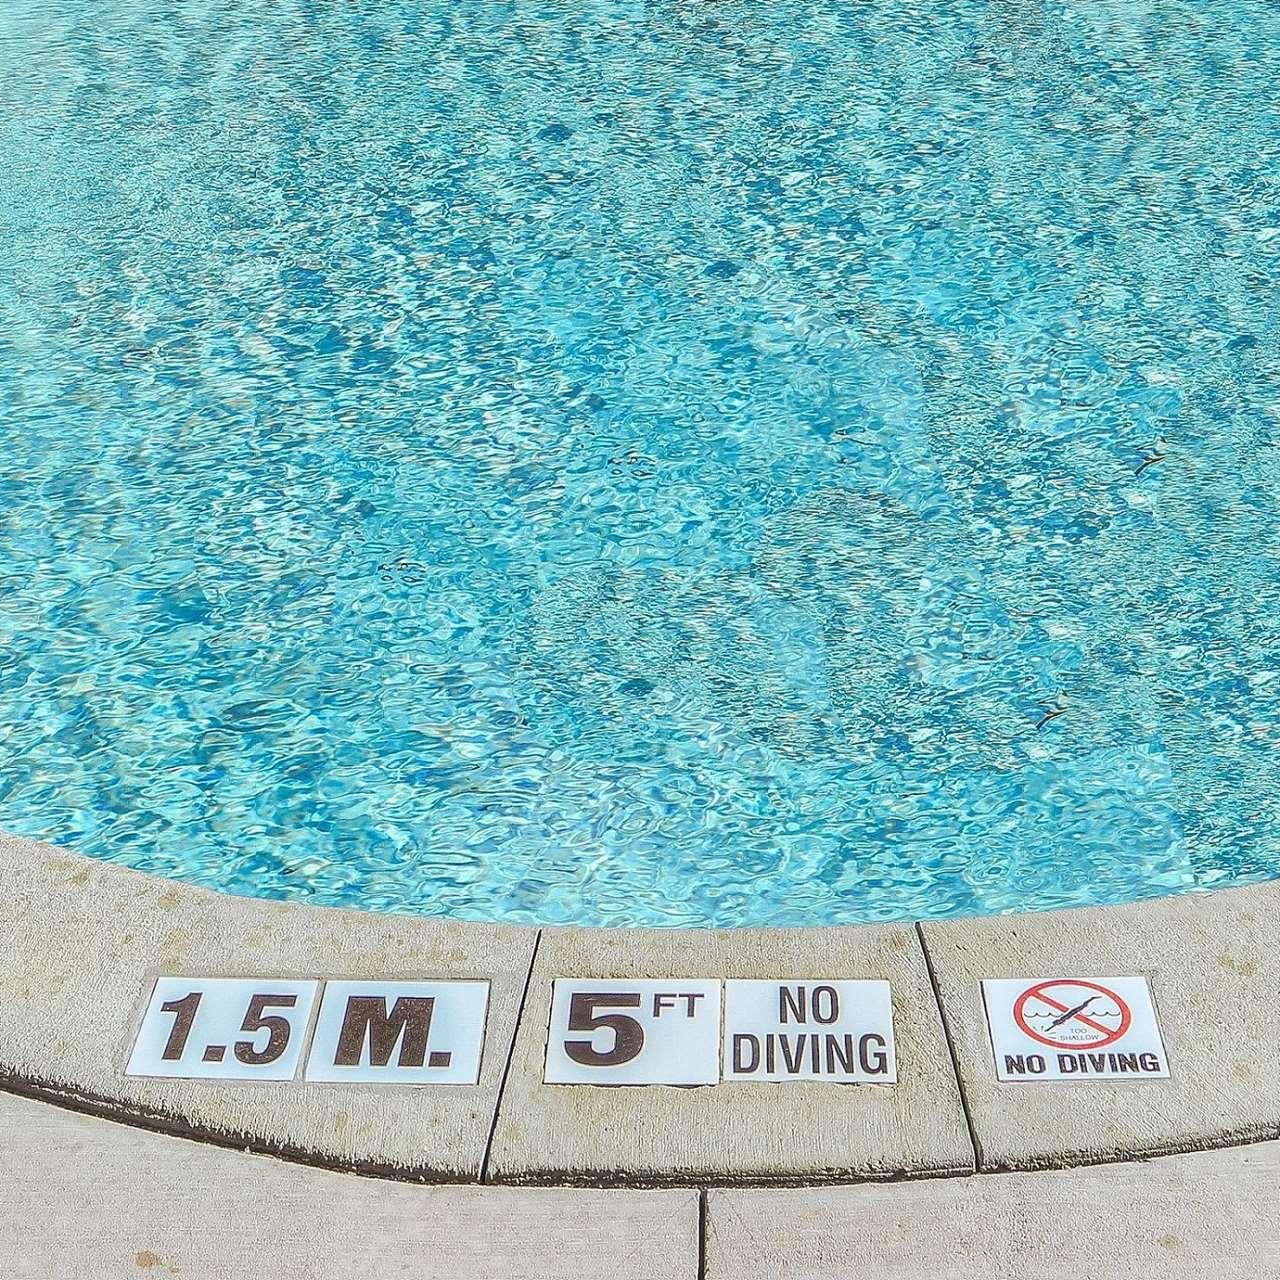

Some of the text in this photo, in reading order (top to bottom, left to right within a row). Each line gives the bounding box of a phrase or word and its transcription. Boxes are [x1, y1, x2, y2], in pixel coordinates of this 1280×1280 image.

[779, 986, 840, 1025] NO
[160, 992, 452, 1067] 1.5 M.
[563, 992, 705, 1067] 5 FT
[1060, 1034, 1100, 1042] SHALLOW
[732, 1032, 888, 1075] DIVING
[1004, 1052, 1161, 1075] NO DIVING
